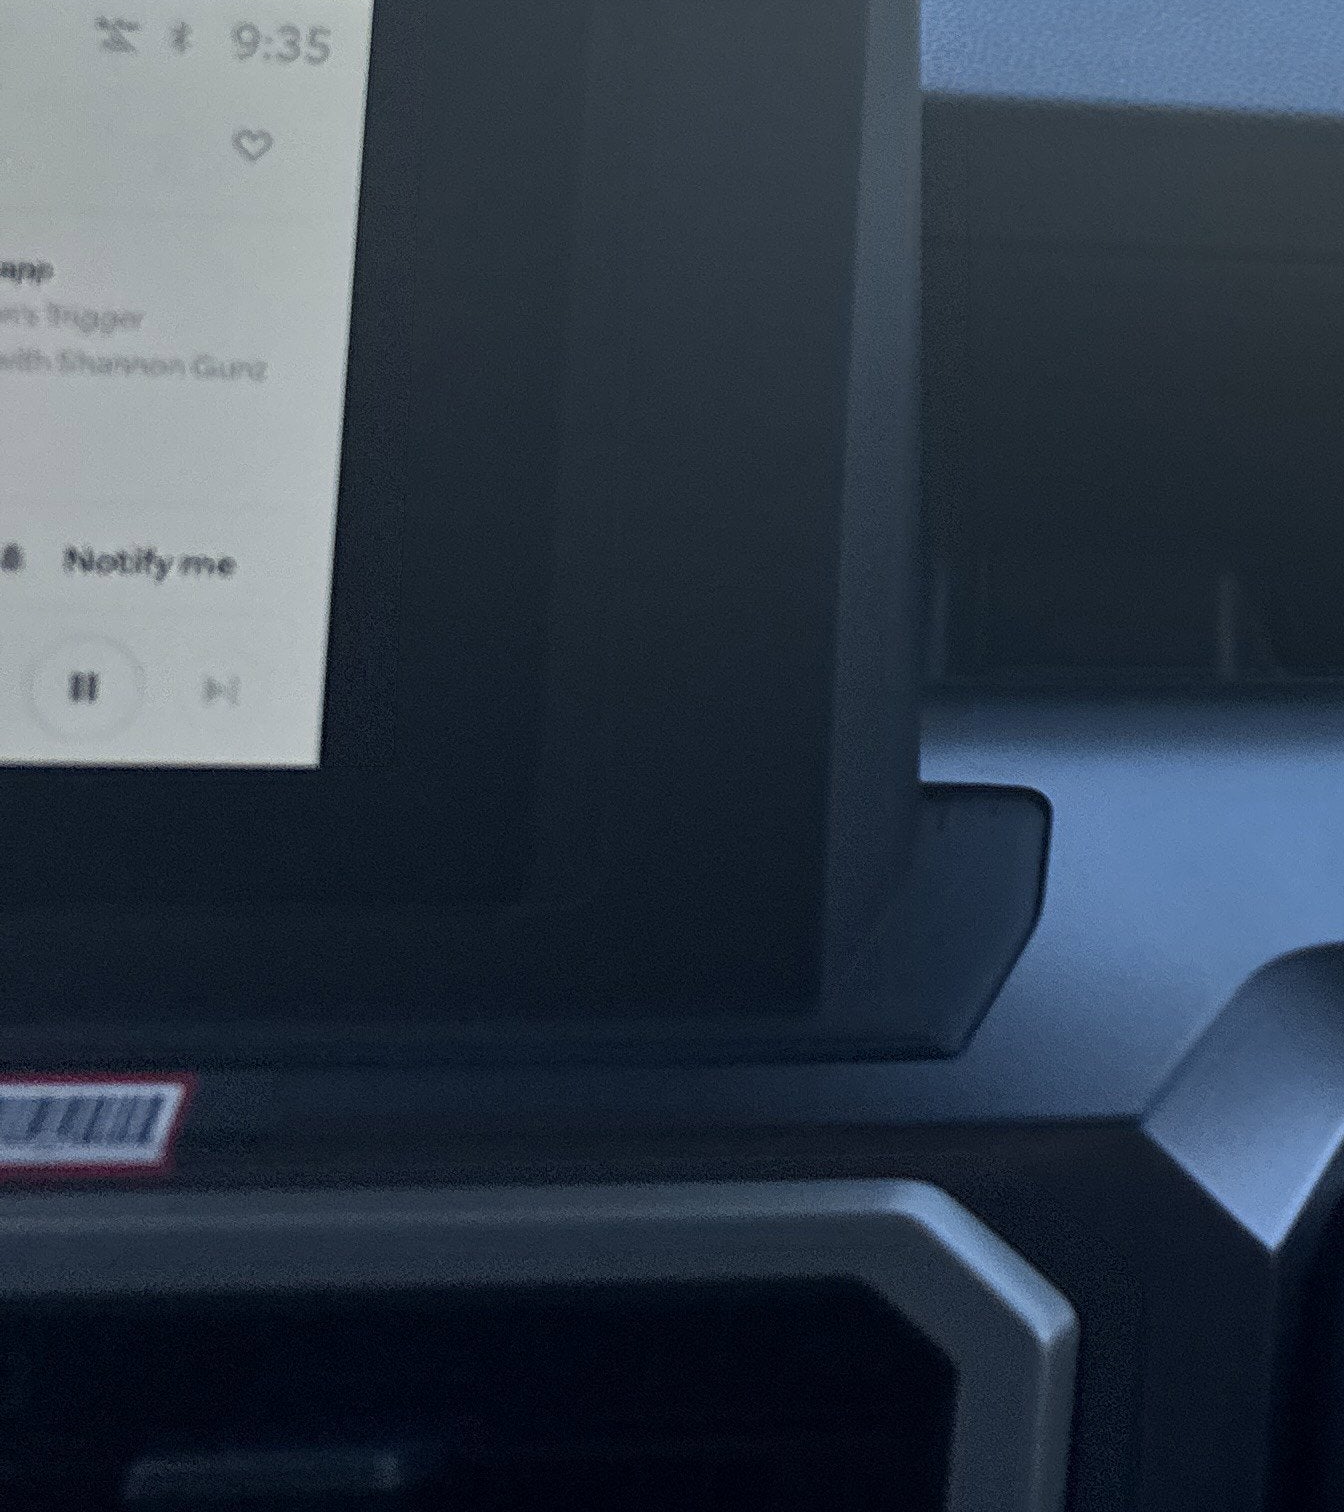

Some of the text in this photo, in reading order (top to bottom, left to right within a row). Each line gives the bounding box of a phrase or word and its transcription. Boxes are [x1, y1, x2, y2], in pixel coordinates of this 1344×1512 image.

[231, 21, 332, 65] 9:35
[56, 350, 186, 379] Shannon
[63, 544, 237, 582] Notify me
